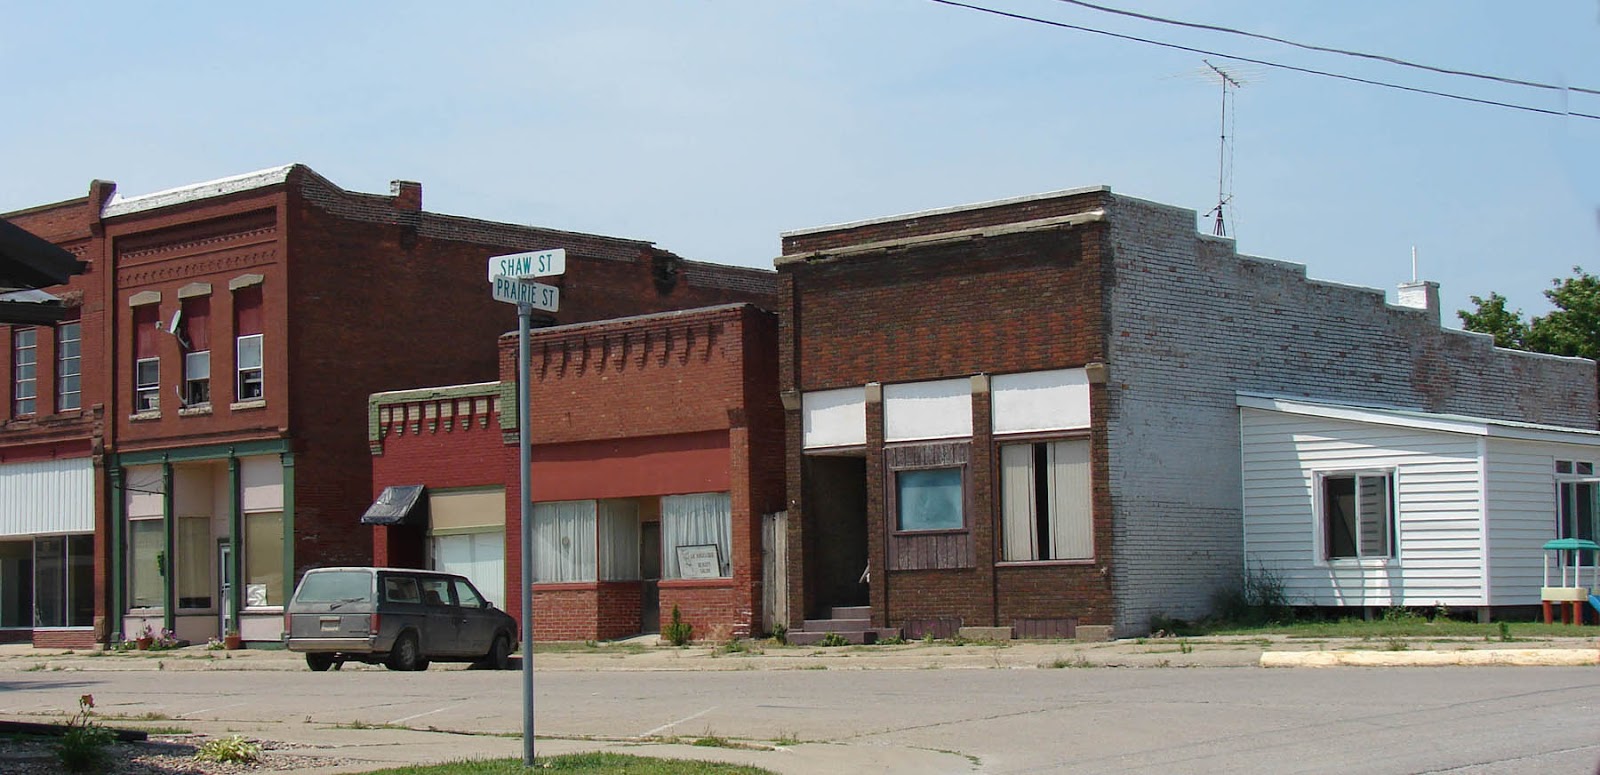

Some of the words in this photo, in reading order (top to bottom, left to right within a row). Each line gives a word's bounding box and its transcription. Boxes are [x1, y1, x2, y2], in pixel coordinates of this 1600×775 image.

[500, 256, 532, 276] SHAW
[538, 254, 552, 273] ST
[497, 278, 537, 304] PRAIRIE
[542, 288, 555, 307] ST
